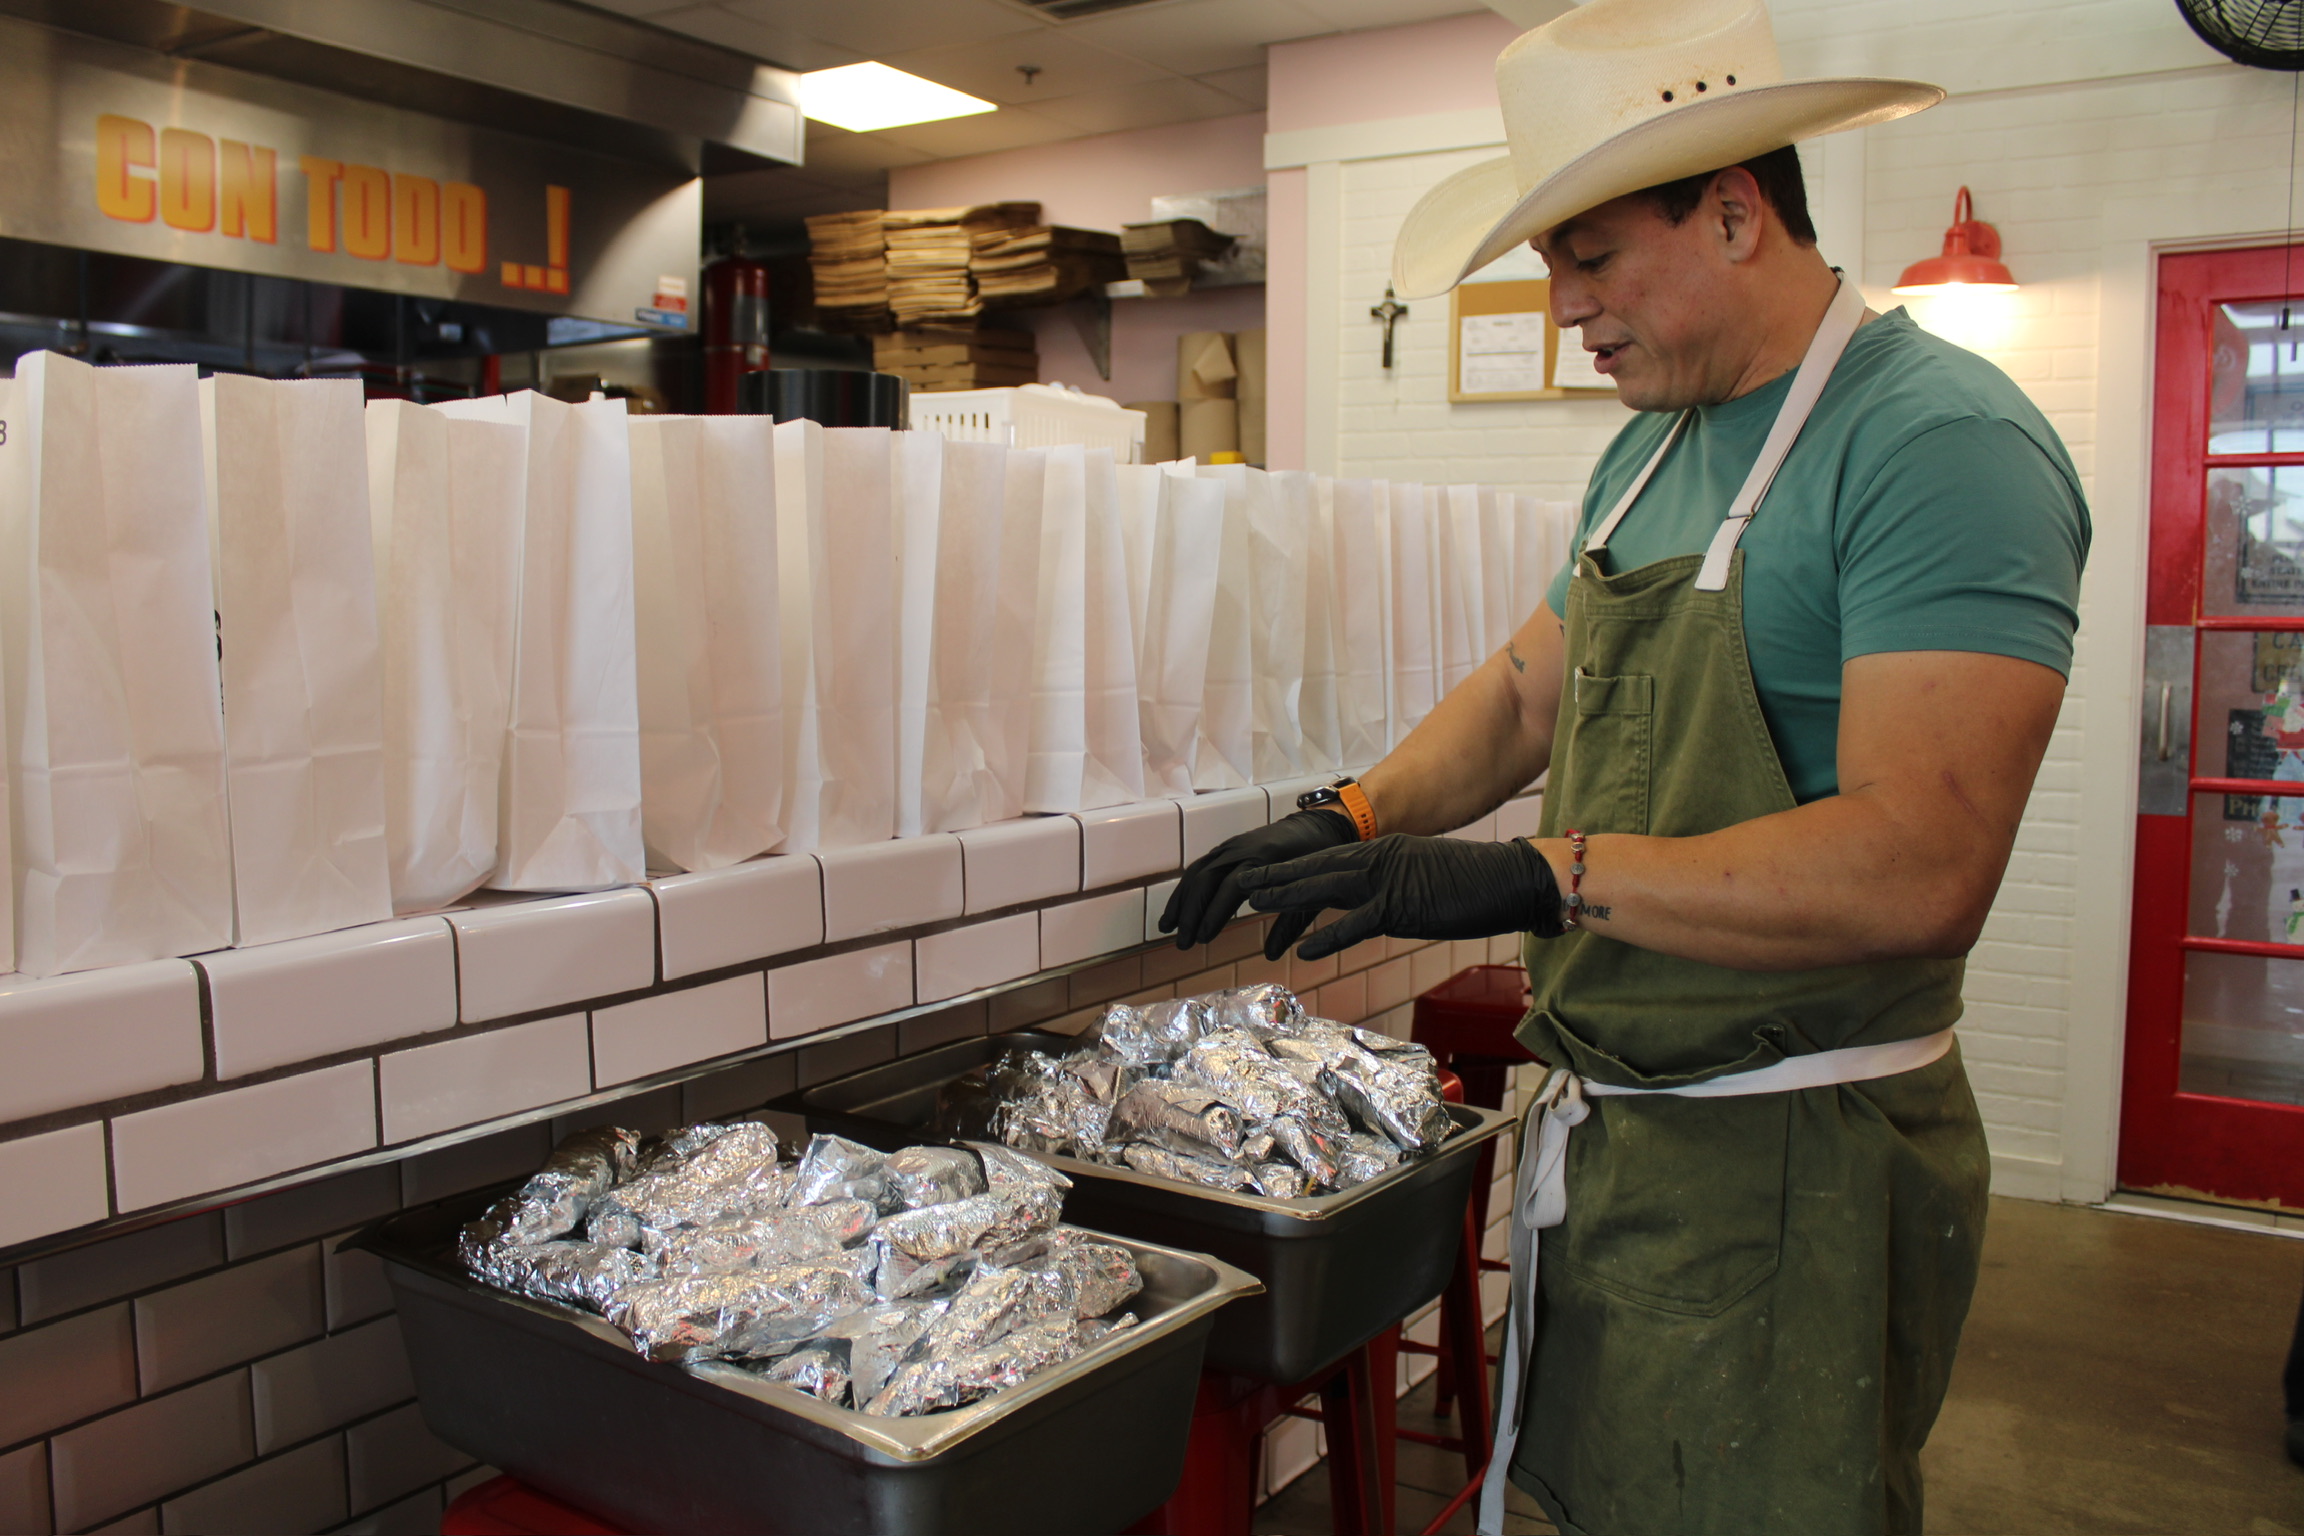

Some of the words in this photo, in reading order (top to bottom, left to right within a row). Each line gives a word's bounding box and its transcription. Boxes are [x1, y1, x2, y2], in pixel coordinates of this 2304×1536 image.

[96, 113, 277, 245] CON
[300, 154, 488, 275] TODO
[1580, 903, 1612, 921] MORE
